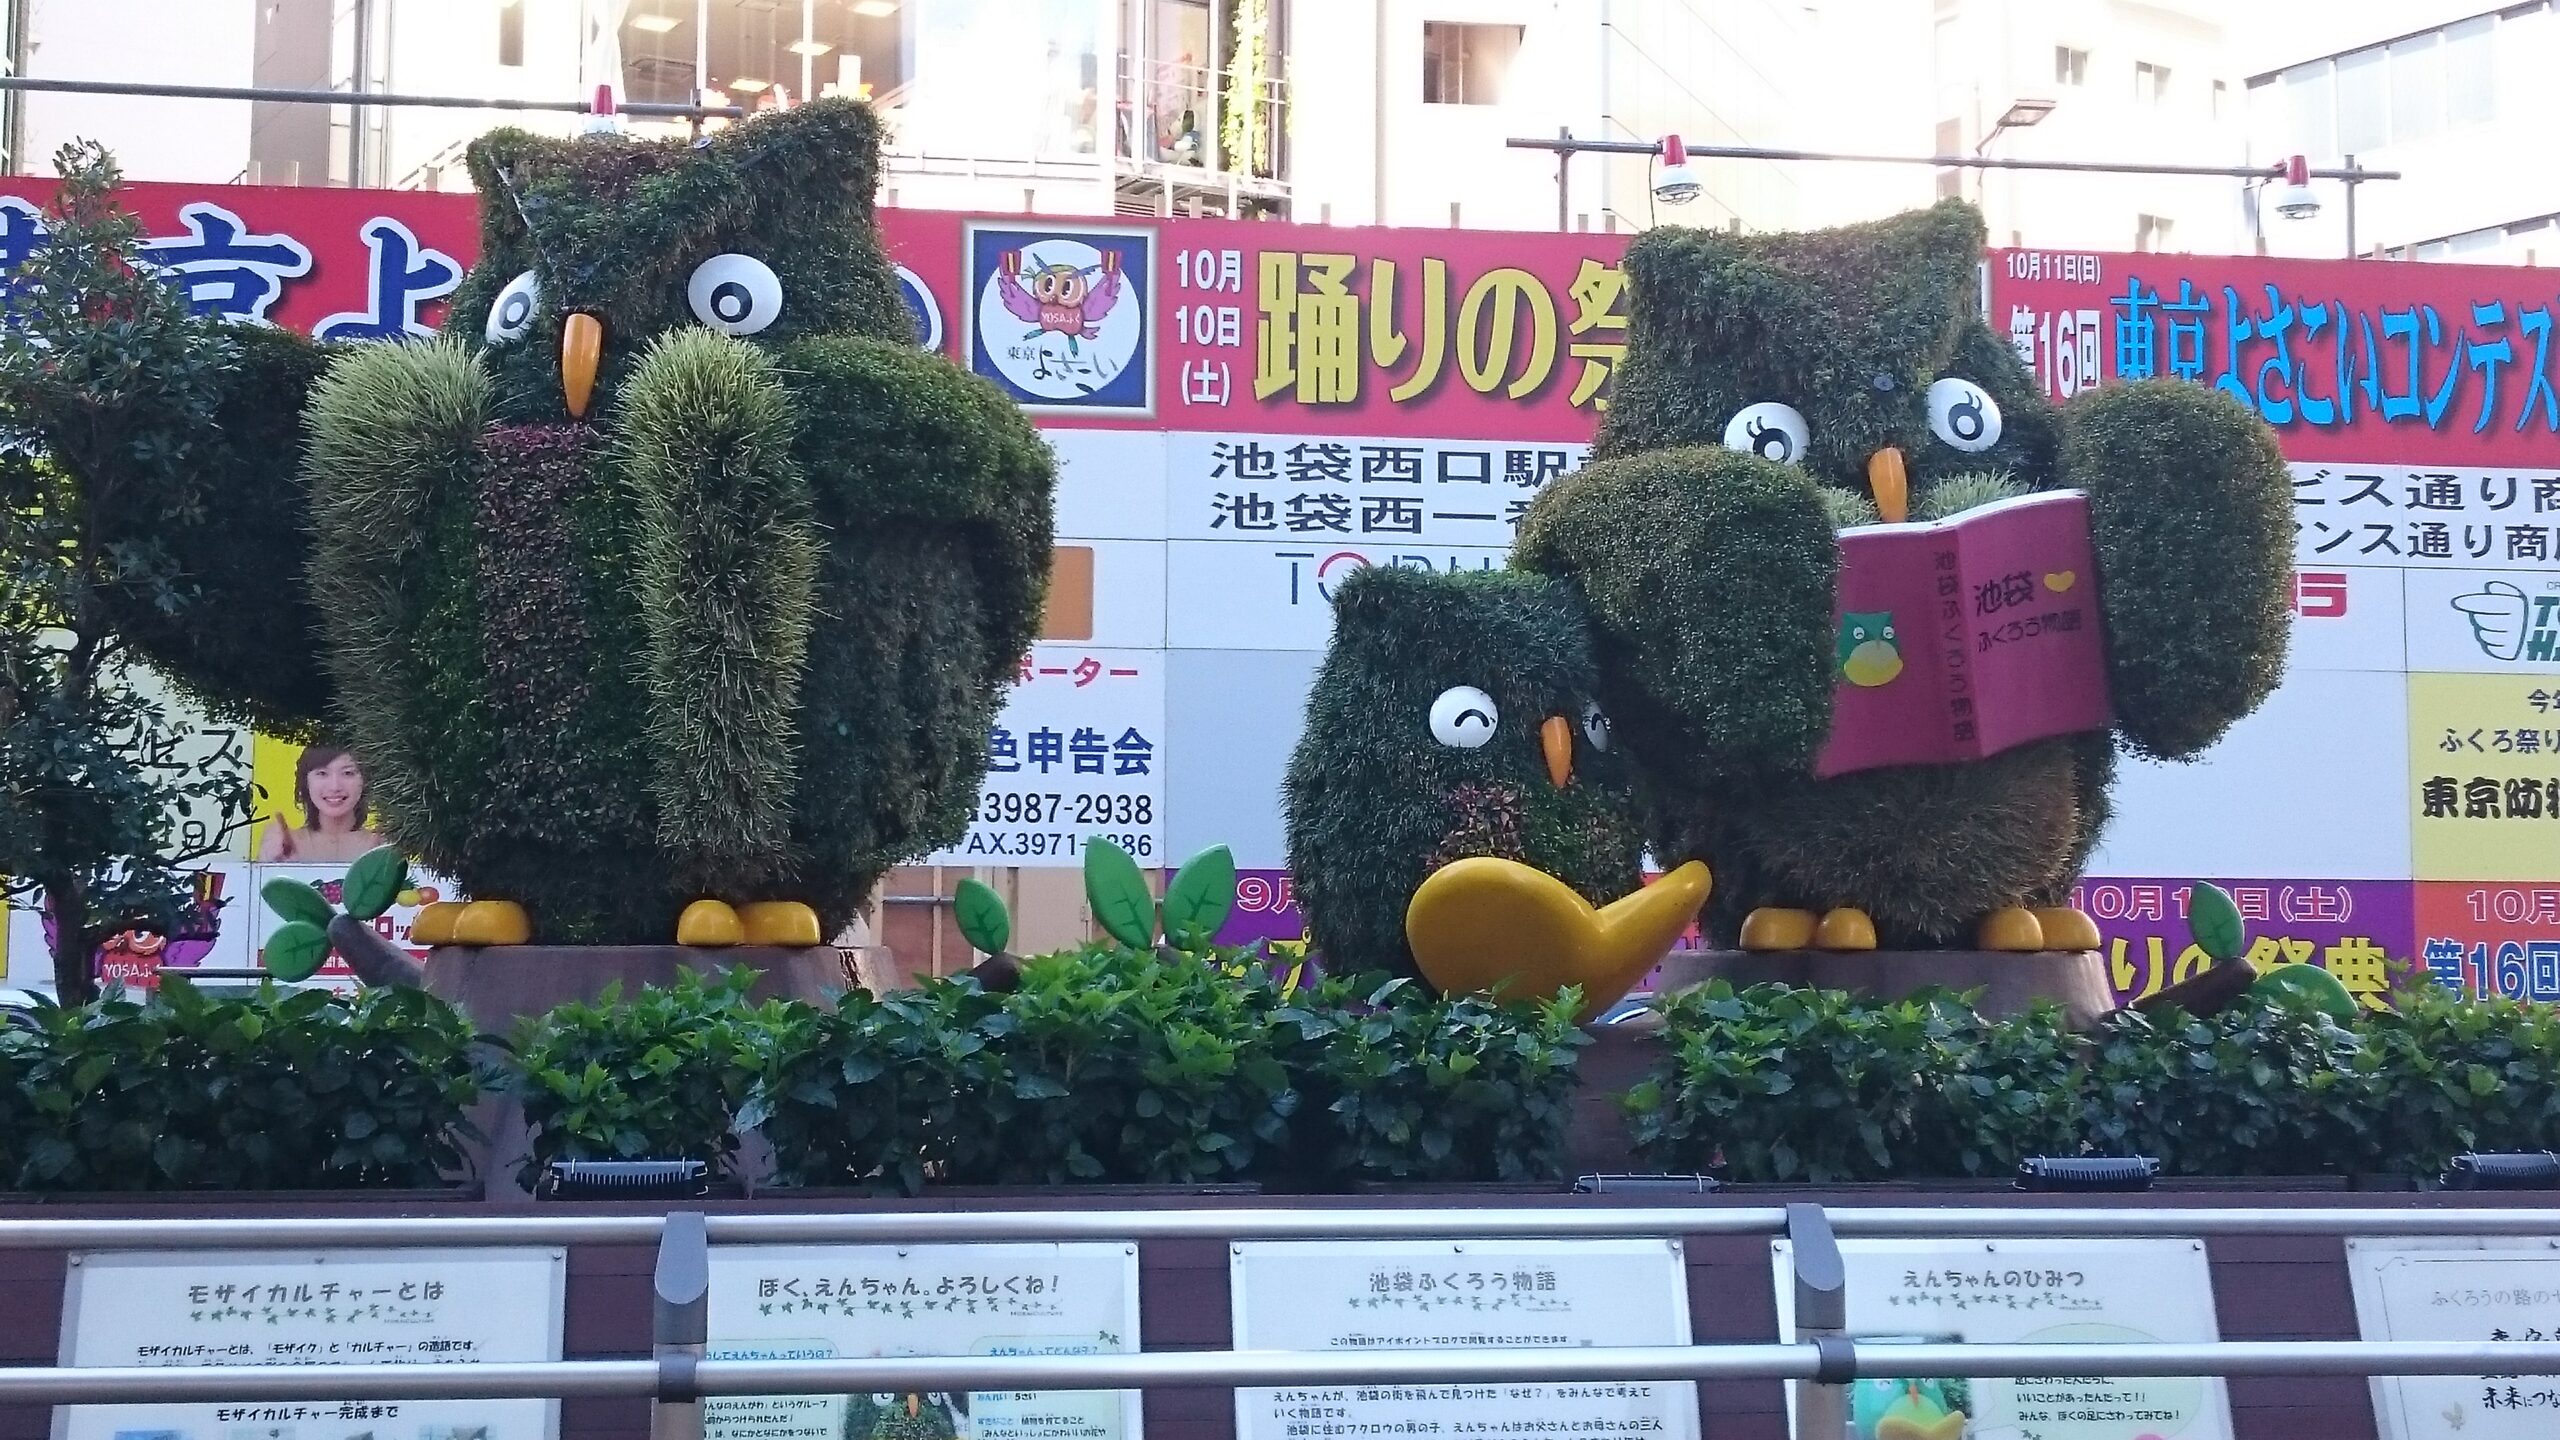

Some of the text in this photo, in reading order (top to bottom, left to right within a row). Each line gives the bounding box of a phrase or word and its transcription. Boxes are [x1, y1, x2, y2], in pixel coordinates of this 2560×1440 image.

[1176, 249, 1242, 293] 10月
[2007, 252, 2101, 285] 10月11日(日)
[1176, 304, 1242, 347] 10日
[1181, 359, 1231, 407] (土)
[1210, 441, 1592, 489] 池袋西口駅
[2294, 521, 2560, 561] ンス通り商
[1974, 569, 2034, 617] 池袋
[1978, 608, 2082, 652] ふくろう物語
[2070, 885, 2352, 923] 10月1日(土)
[2467, 889, 2560, 924] 10月
[188, 1281, 444, 1304] モザイカルチャーとは
[1370, 1271, 1557, 1293] 池袋ふくろう物語
[1904, 1270, 2085, 1288] えんちゃんのひみつ
[217, 1405, 399, 1422] モザイカルチャー完成まで
